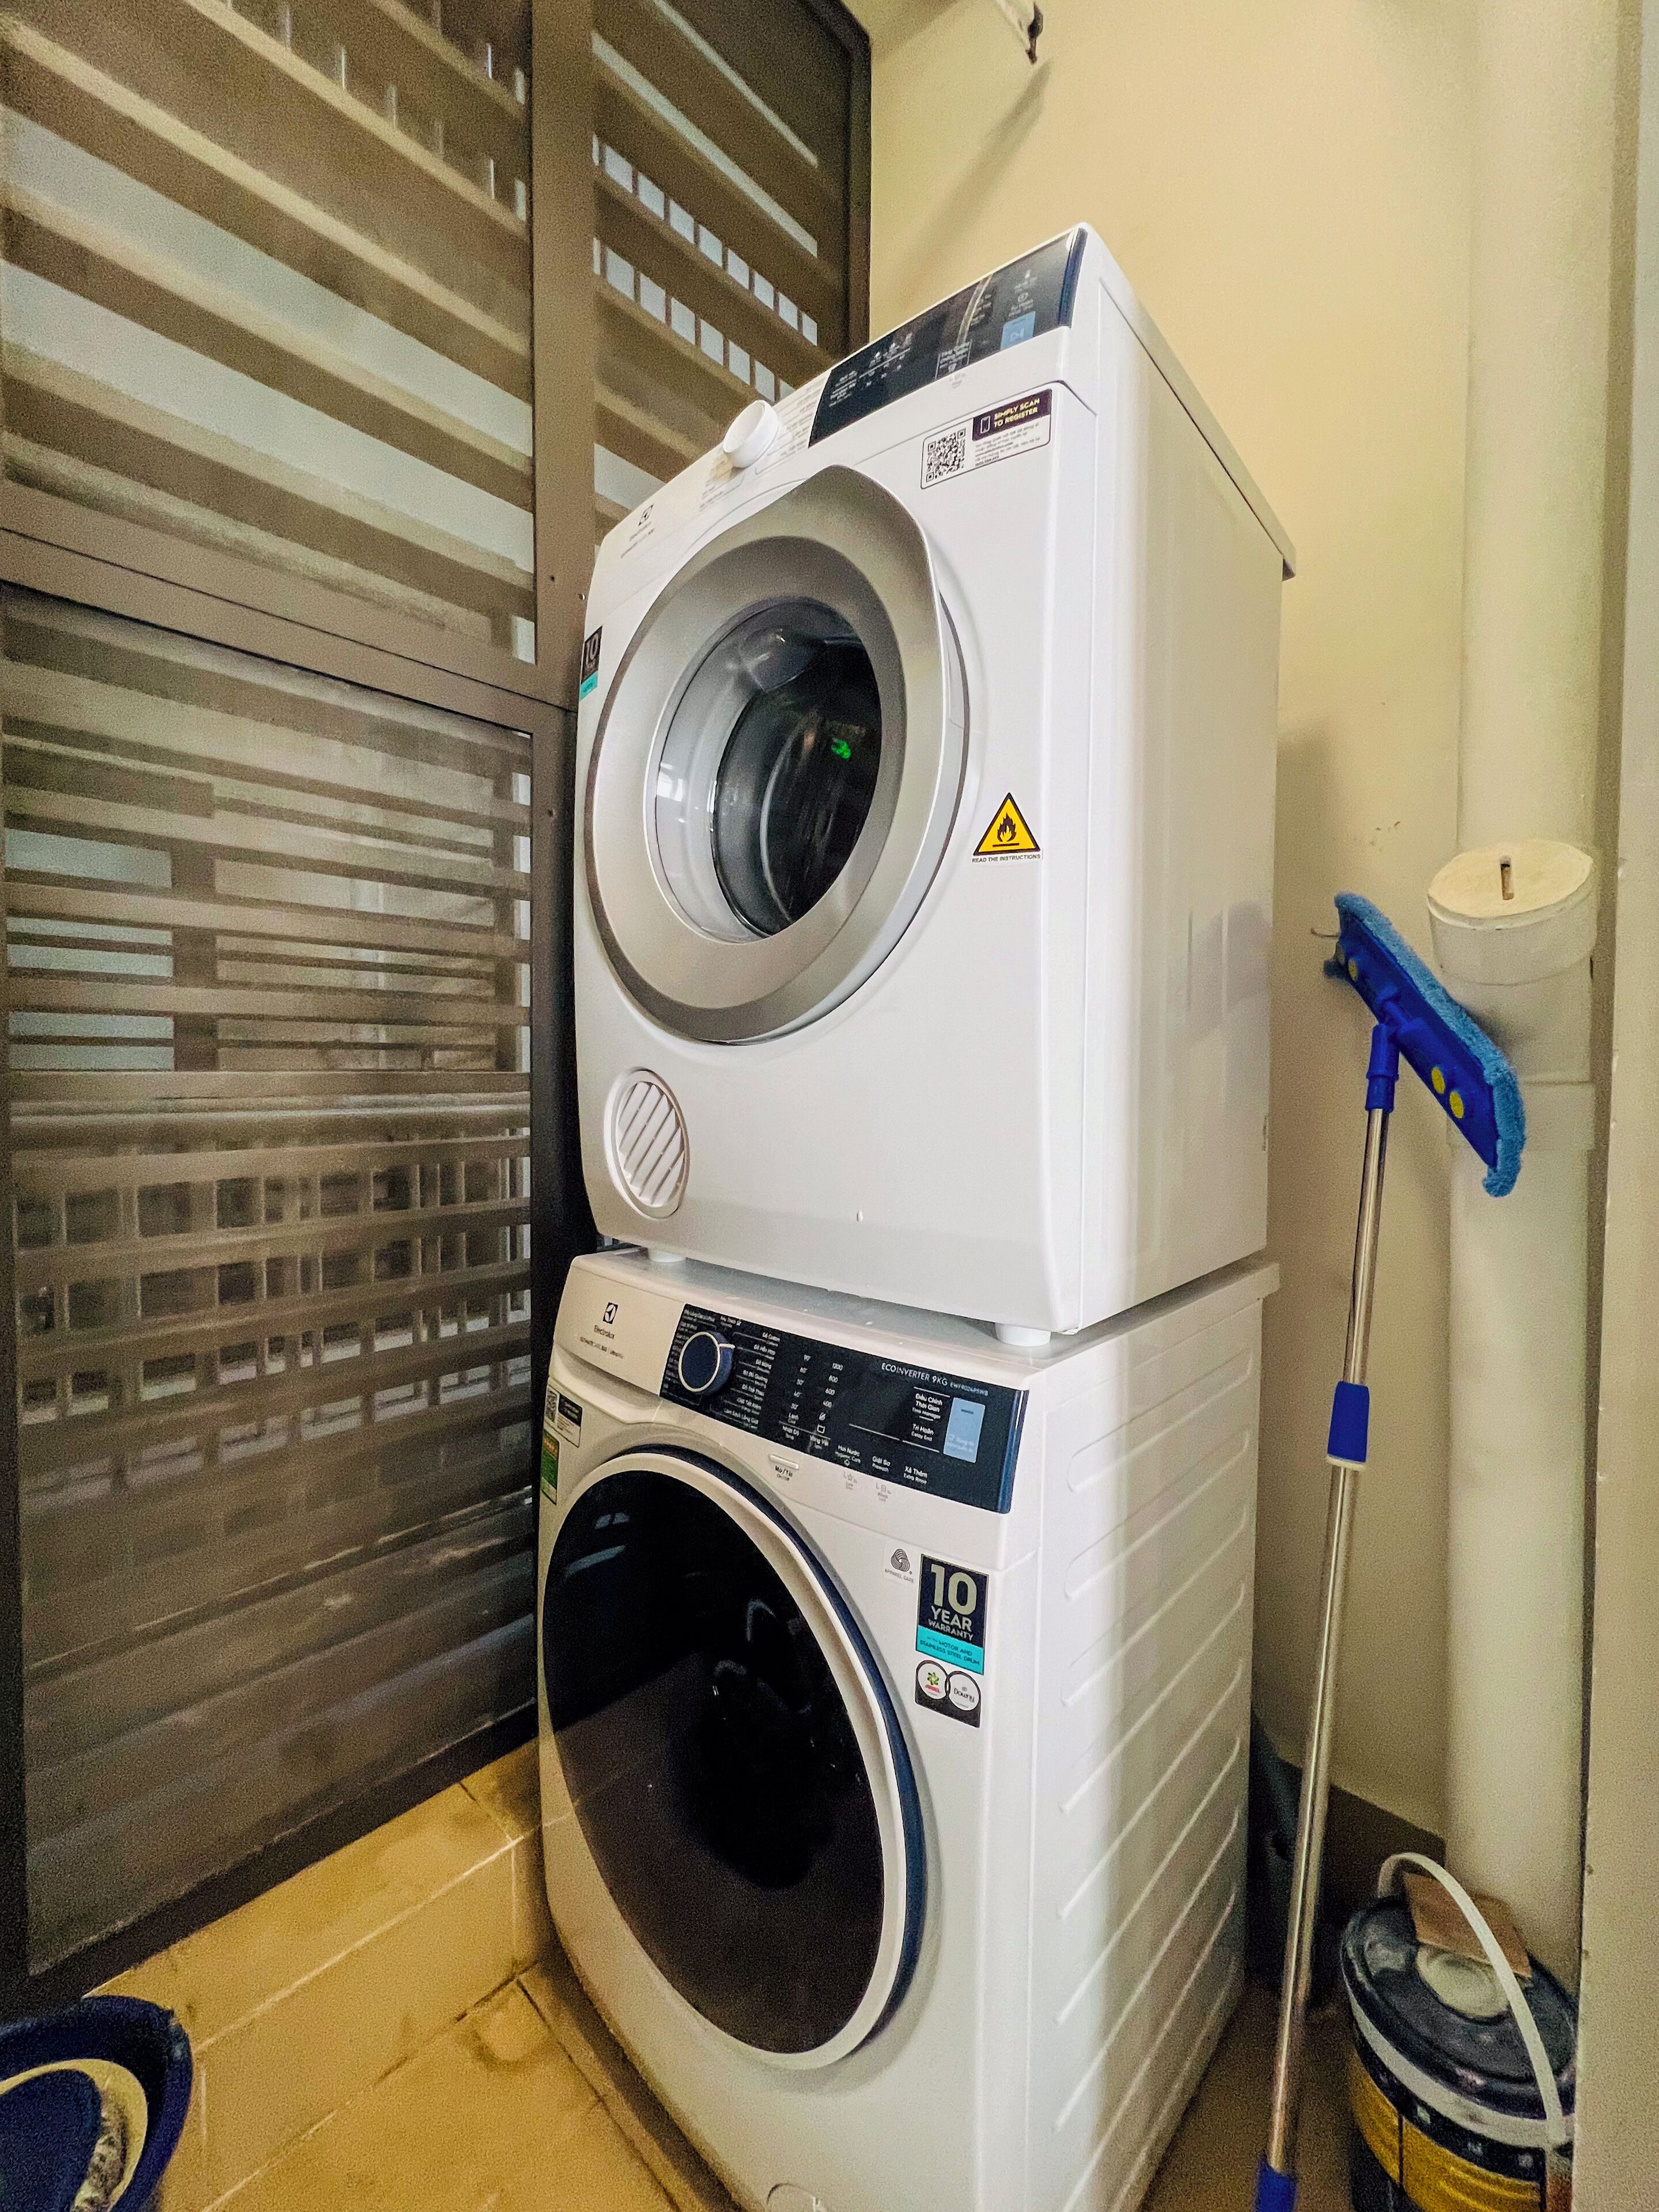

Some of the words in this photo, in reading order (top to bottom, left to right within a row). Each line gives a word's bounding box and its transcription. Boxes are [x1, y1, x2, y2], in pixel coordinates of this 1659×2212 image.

[994, 406, 1018, 421] SIMPLY
[1020, 397, 1040, 410] SCAN
[994, 420, 1004, 428] TO
[1005, 407, 1039, 423] REGISTER
[586, 633, 599, 665] 10
[594, 1324, 615, 1340] Electrolux
[832, 1362, 844, 1372] 1200
[881, 1362, 930, 1381] ECOINVERTER
[931, 1374, 948, 1387] 9KG
[828, 1375, 839, 1383] 800
[825, 1387, 835, 1396] 600
[823, 1399, 832, 1408] 400
[927, 1404, 940, 1412] Gian
[911, 1431, 923, 1440] Delay
[930, 1563, 977, 1616] 10
[930, 1605, 972, 1633] YEAR
[927, 1618, 974, 1642] WARRANTY
[919, 1639, 946, 1654] STAINLESS
[947, 1650, 962, 1660] STEEL
[963, 1656, 980, 1666] DRUM
[938, 1639, 959, 1652] MOTOR
[960, 1648, 973, 1656] AND
[953, 1688, 975, 1703] Downy
